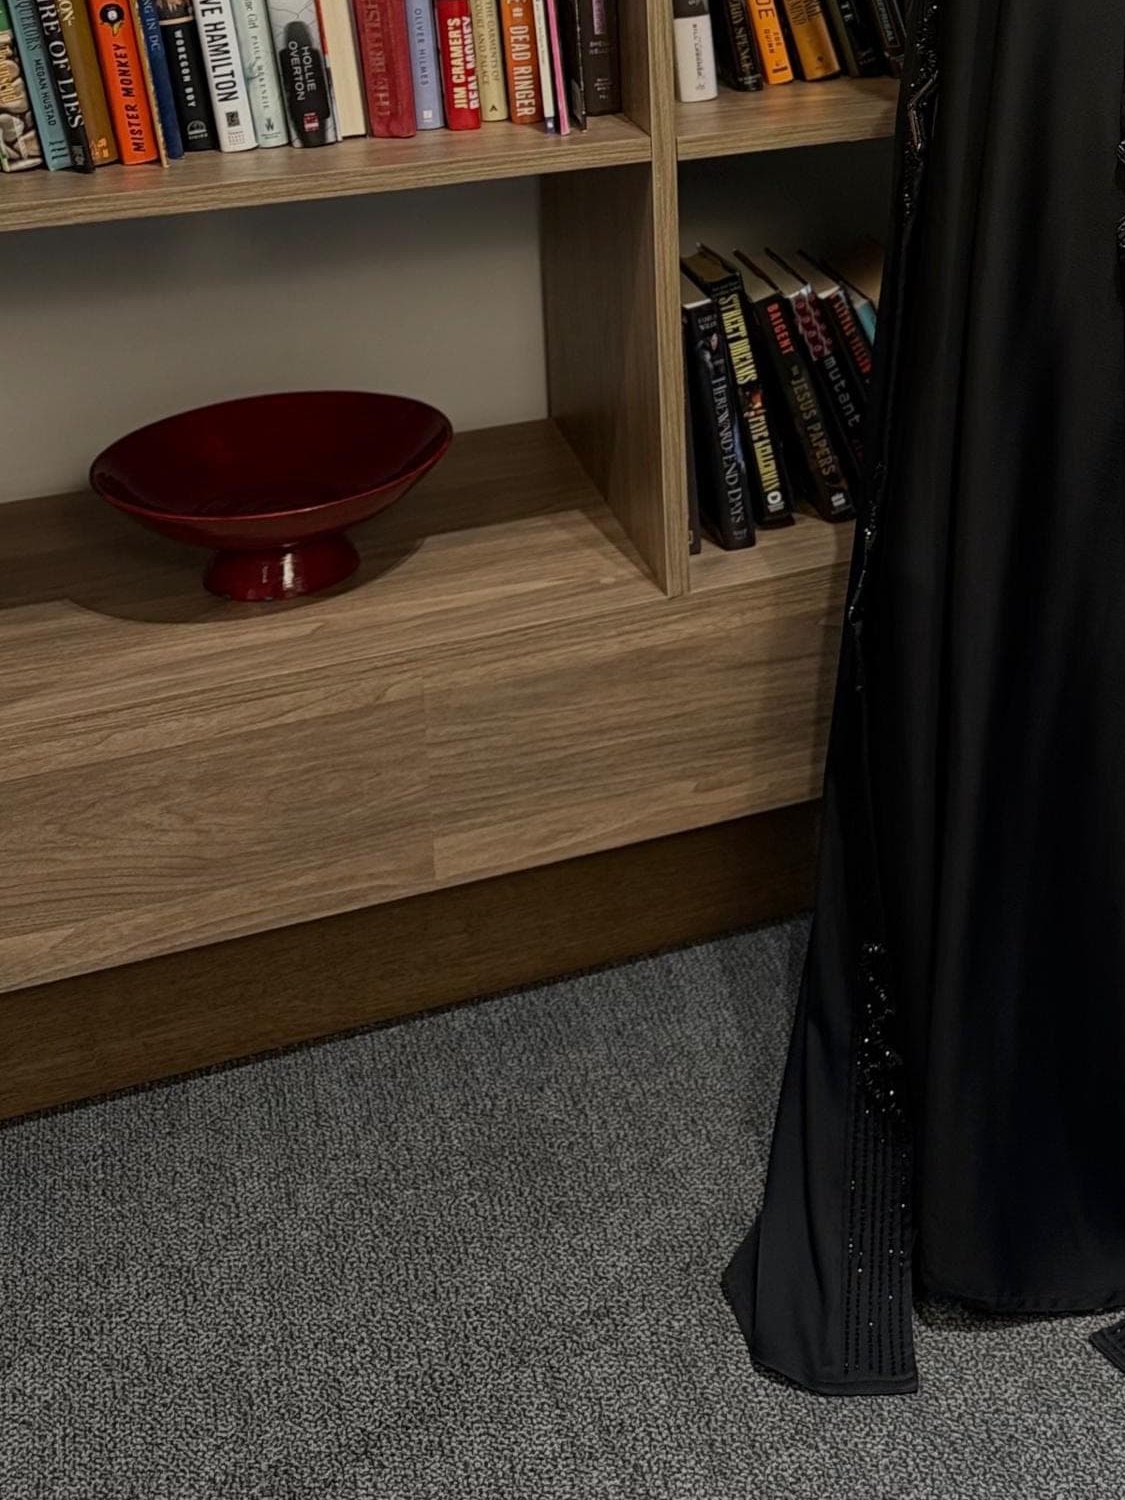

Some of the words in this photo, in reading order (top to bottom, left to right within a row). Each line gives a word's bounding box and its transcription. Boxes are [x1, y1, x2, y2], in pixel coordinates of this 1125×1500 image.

[145, 16, 157, 31] IN
[246, 13, 259, 29] Girl
[413, 7, 425, 43] OLIVER
[484, 0, 493, 17] THE
[788, 0, 807, 26] MIND
[46, 39, 71, 74] OF
[148, 34, 161, 51] DC
[446, 17, 465, 83] CRAMER'S
[462, 15, 475, 68] MONEY
[476, 32, 487, 51] AND
[485, 19, 499, 67] GARMENTS
[508, 24, 532, 61] DEAD
[762, 27, 776, 54] QUINN
[111, 41, 135, 99] MONKEY
[172, 30, 192, 82] WOBEGON
[184, 86, 196, 108] BOY
[202, 20, 239, 103] HAMILTON
[286, 40, 306, 101] OVERTON
[299, 45, 317, 92] HOLLIE
[417, 49, 429, 85] HILMES
[478, 54, 490, 85] PALACE
[32, 58, 47, 89] MEGAN
[40, 90, 56, 126] HUSTAD
[55, 75, 86, 129] LIES
[368, 78, 391, 116] THE
[454, 86, 468, 109] JIM
[467, 72, 479, 108] REAL
[511, 65, 537, 116] RINGER
[123, 102, 147, 153] MISTER
[717, 293, 747, 340] STREET
[727, 338, 758, 385] DREAMS
[765, 302, 794, 355] BAIGENT
[789, 376, 816, 420] JESUS
[806, 421, 836, 476] PAPERS
[820, 355, 863, 428] mutant
[720, 453, 740, 485] END
[725, 488, 747, 523] DAYS
